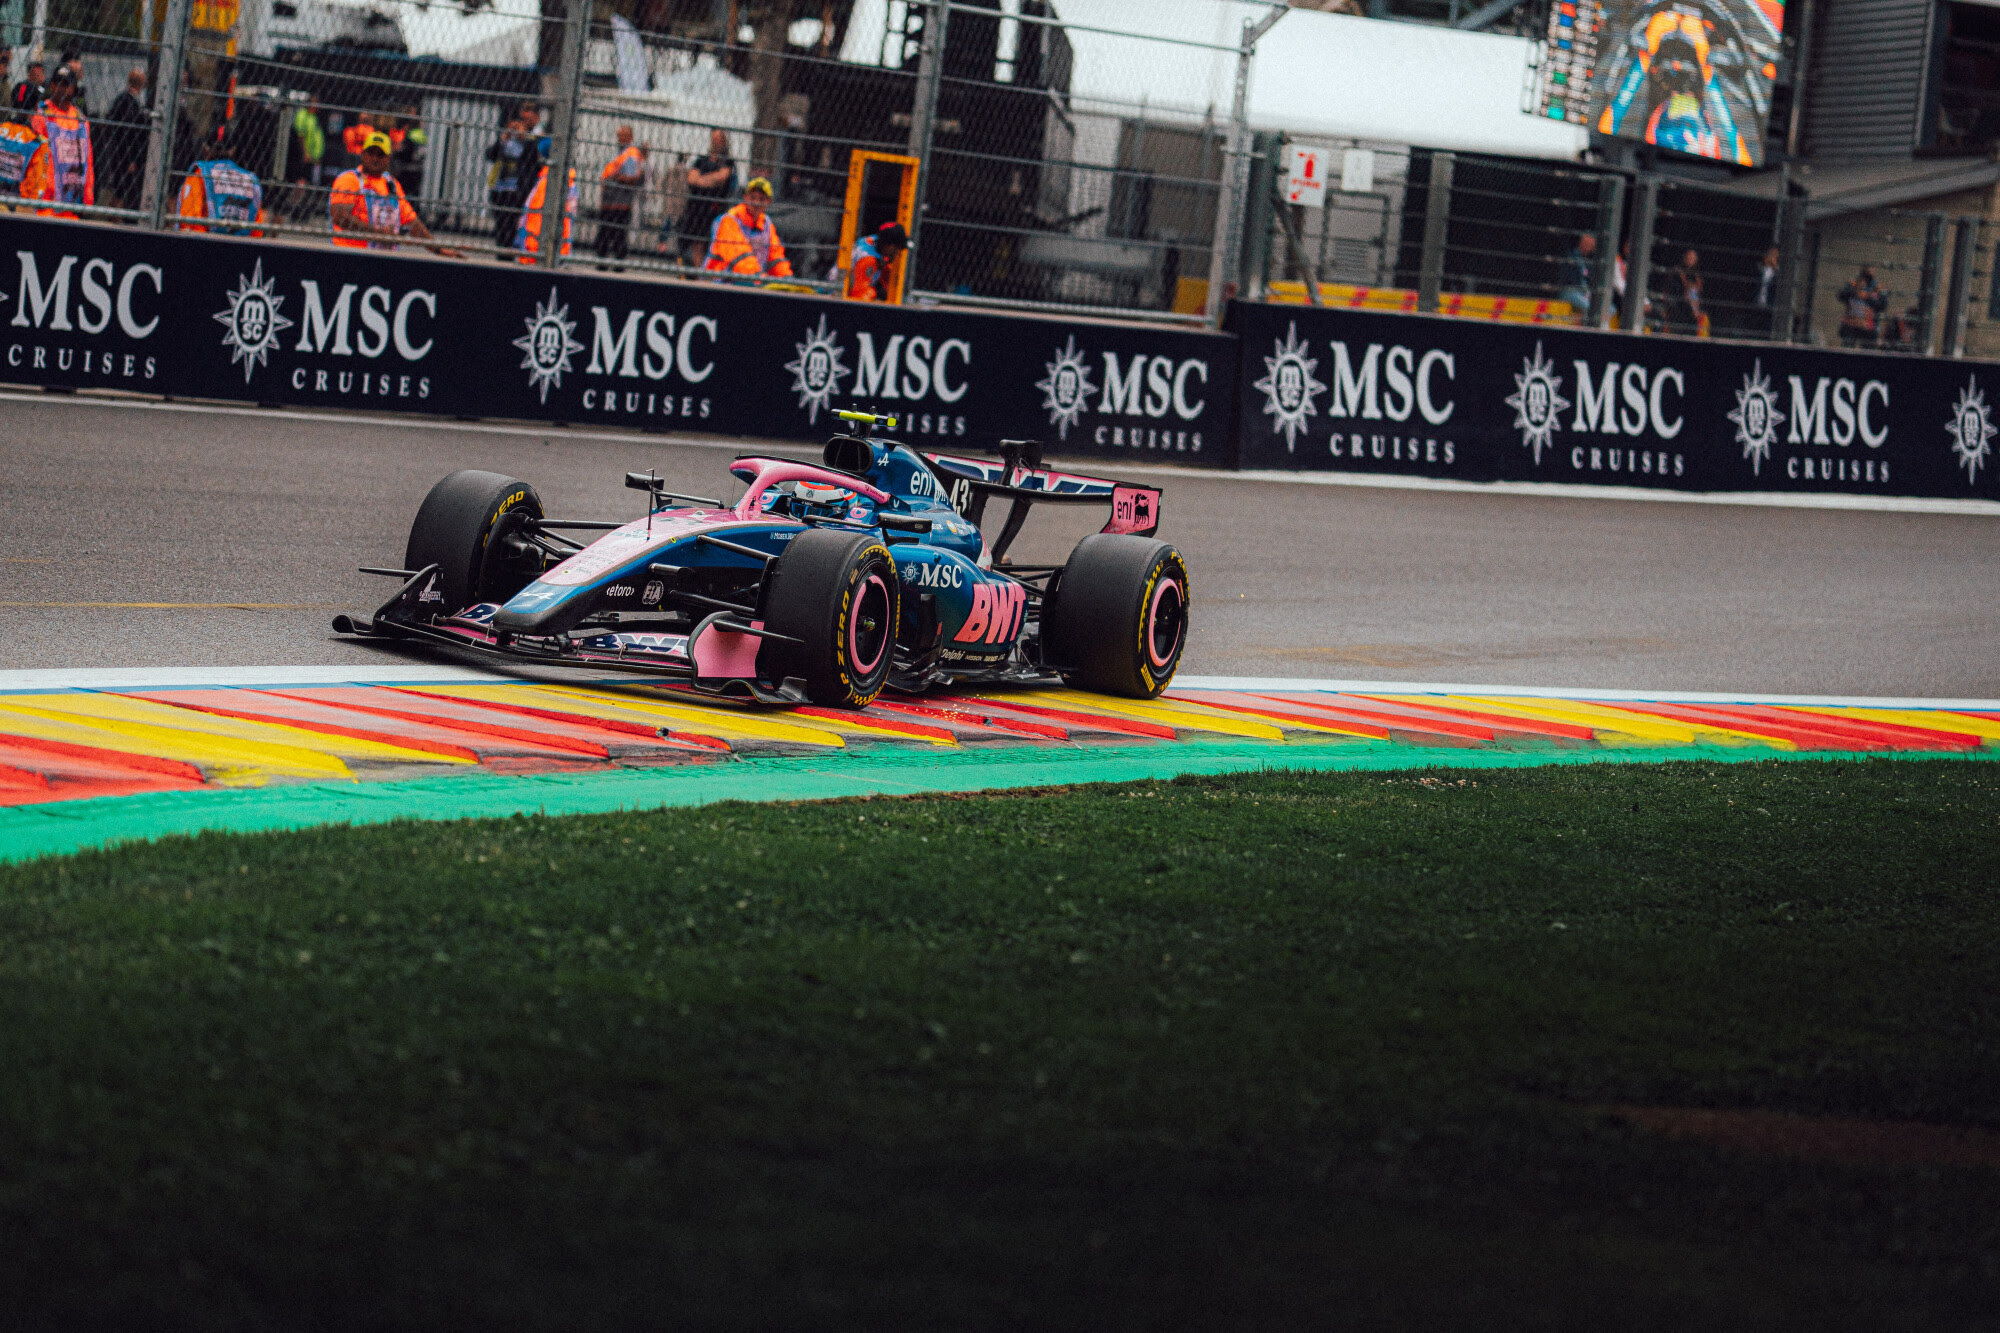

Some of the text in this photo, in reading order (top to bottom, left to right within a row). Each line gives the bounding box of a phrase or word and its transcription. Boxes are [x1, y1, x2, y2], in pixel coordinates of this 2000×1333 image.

[11, 251, 162, 338] MSC
[295, 280, 437, 361] MSC
[586, 306, 717, 383] MSC
[8, 345, 156, 379] CRUISES
[851, 332, 970, 402] MSC
[292, 368, 430, 398] CRUISES
[1098, 352, 1207, 420] MSC
[1329, 341, 1455, 425] MSC
[1572, 360, 1684, 439] MSC
[583, 388, 711, 419] CRUISES
[1787, 376, 1889, 448] MSC
[848, 412, 965, 436] UISES
[1095, 426, 1202, 453] CRUISES
[1330, 433, 1455, 464] CRUISES
[1572, 446, 1684, 477] CRUISES
[910, 470, 933, 496] eni
[1787, 457, 1889, 483] CRUISES
[950, 479, 969, 515] 43
[1117, 495, 1133, 520] eni
[643, 585, 661, 600] FIA
[918, 563, 962, 588] MSC
[837, 590, 850, 666] ZERO
[953, 582, 1027, 643] BWT
